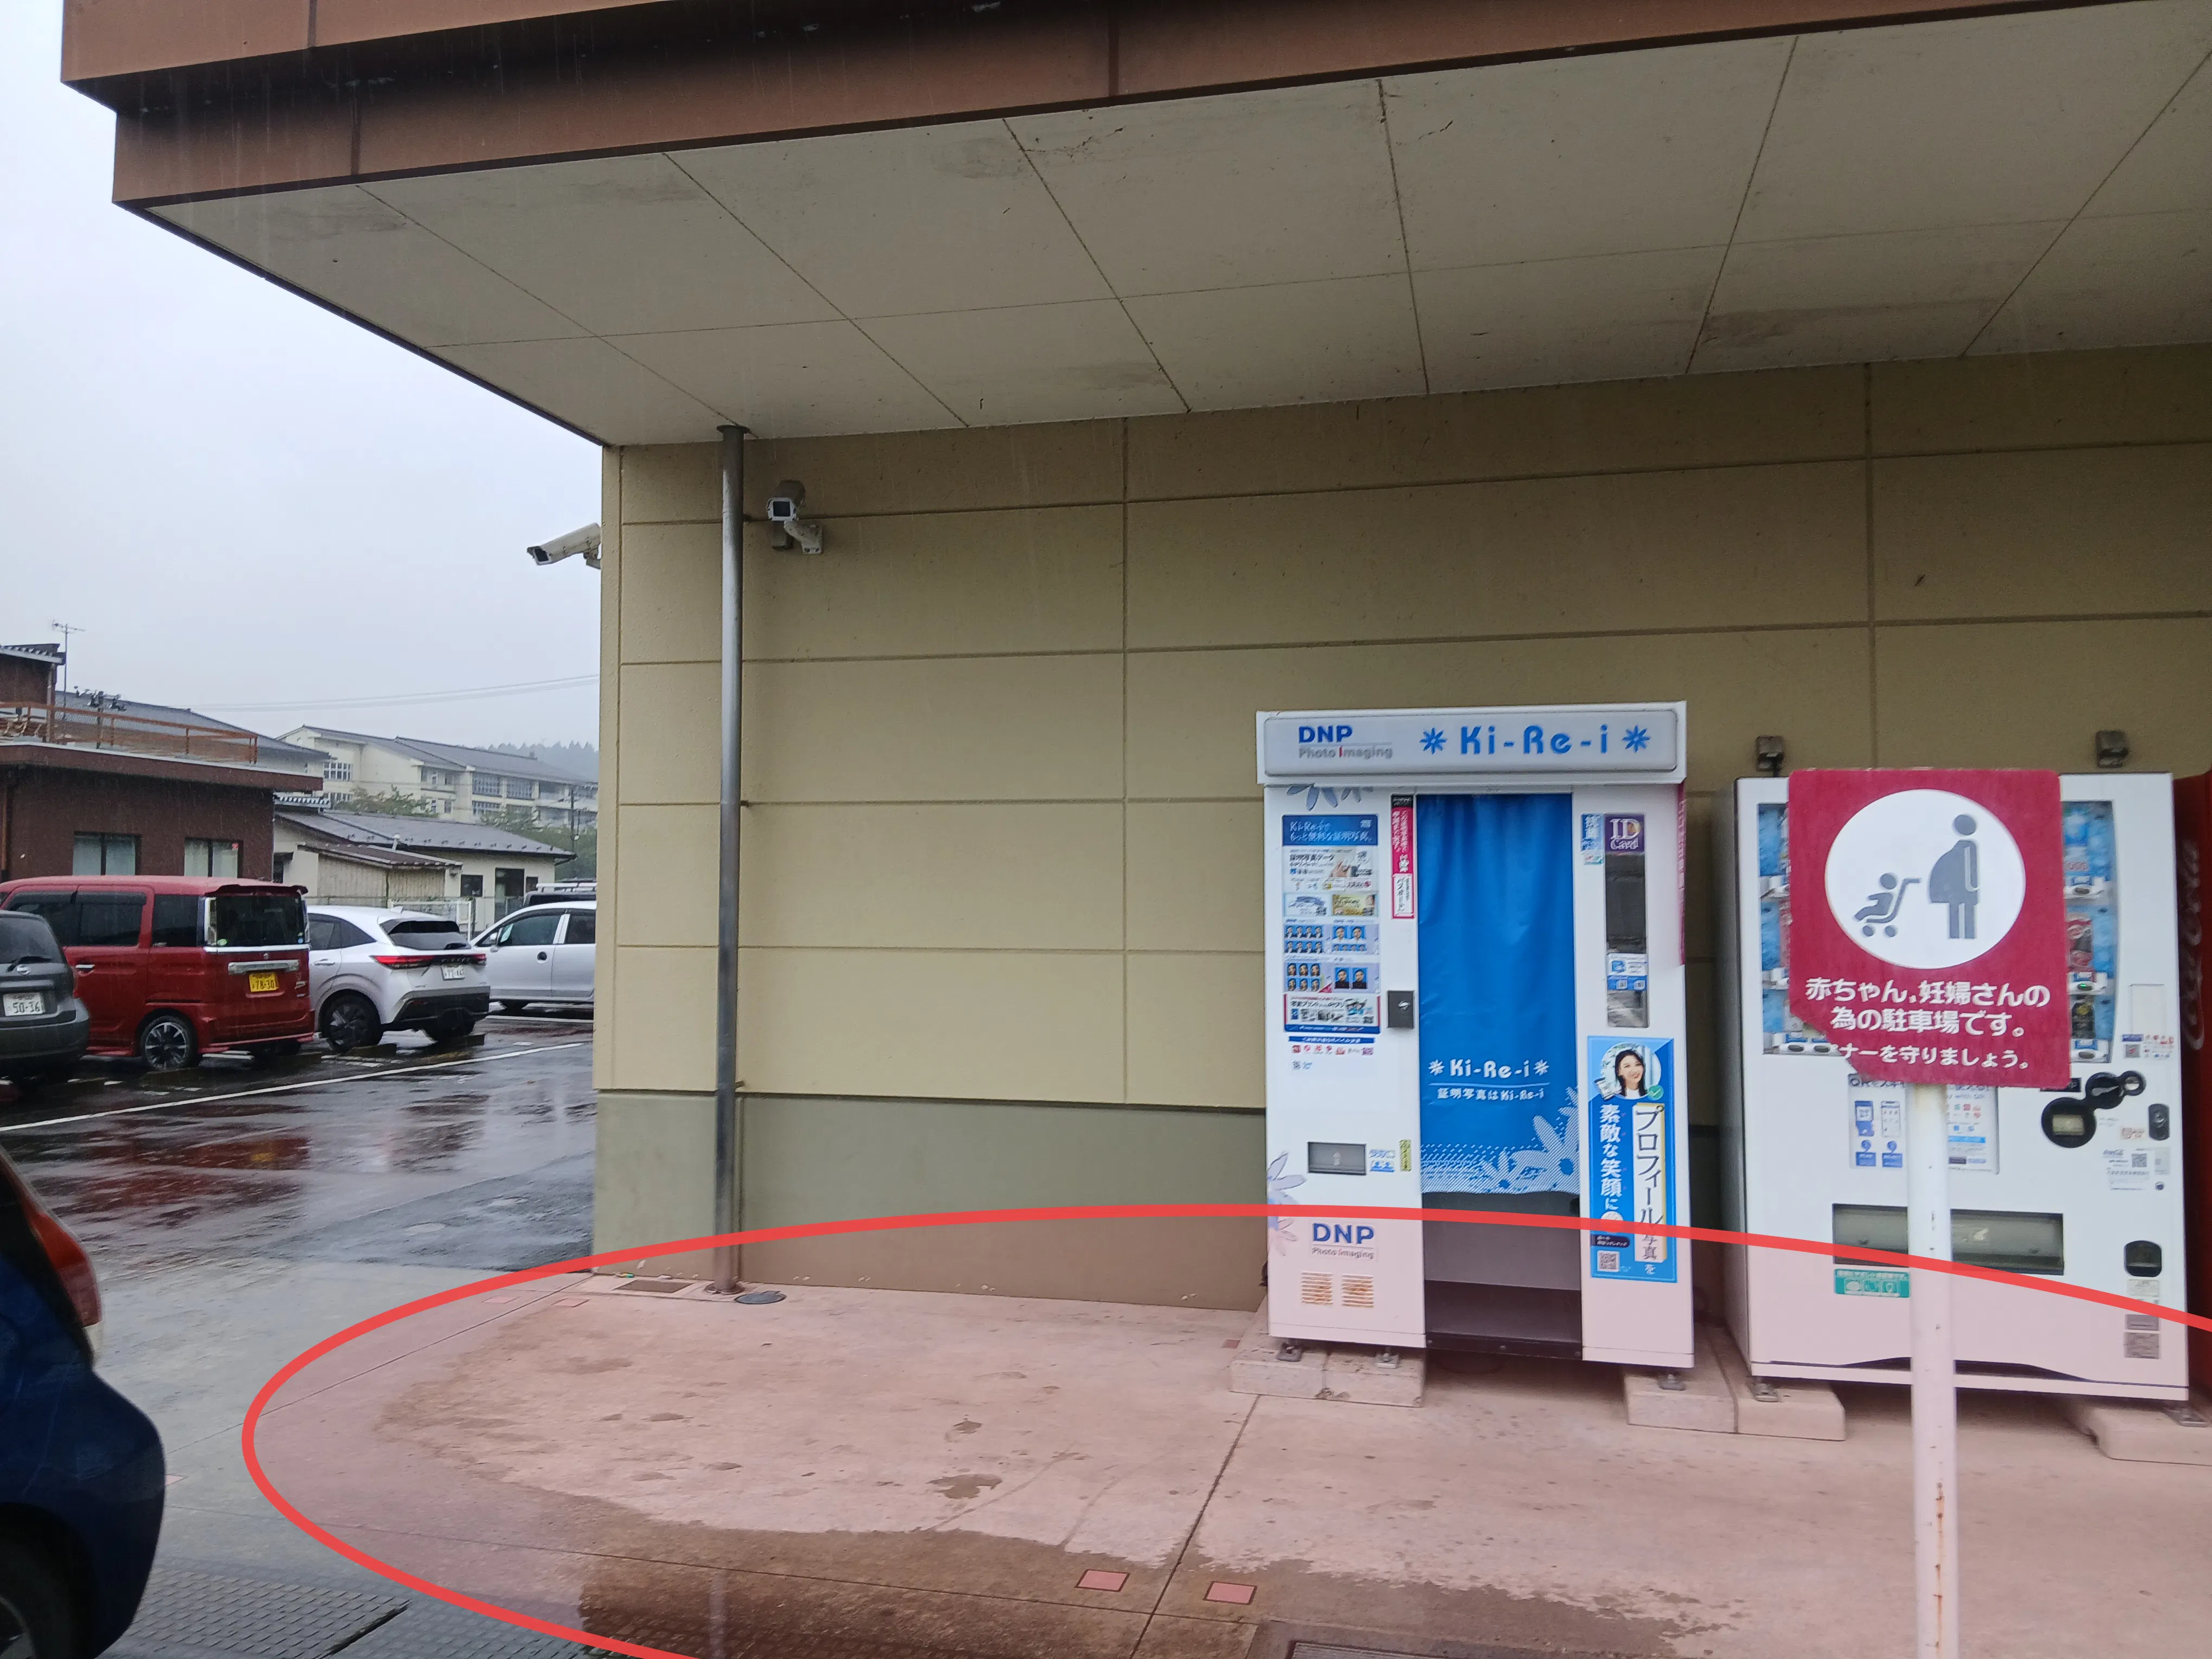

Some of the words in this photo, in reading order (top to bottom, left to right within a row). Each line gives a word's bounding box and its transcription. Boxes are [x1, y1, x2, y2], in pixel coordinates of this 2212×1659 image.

[1298, 725, 1353, 743] DNP
[1460, 724, 1609, 755] Ki-Re-i
[1298, 746, 1336, 759] Photo
[1609, 818, 1641, 840] ID
[1610, 837, 1639, 851] Card
[1829, 1006, 2025, 1038] 為の駐車場です。
[1449, 1058, 1531, 1078] Ki-Re-i
[1599, 1103, 1623, 1211] 素敵な笑顔に
[1313, 1223, 1374, 1244] DNP
